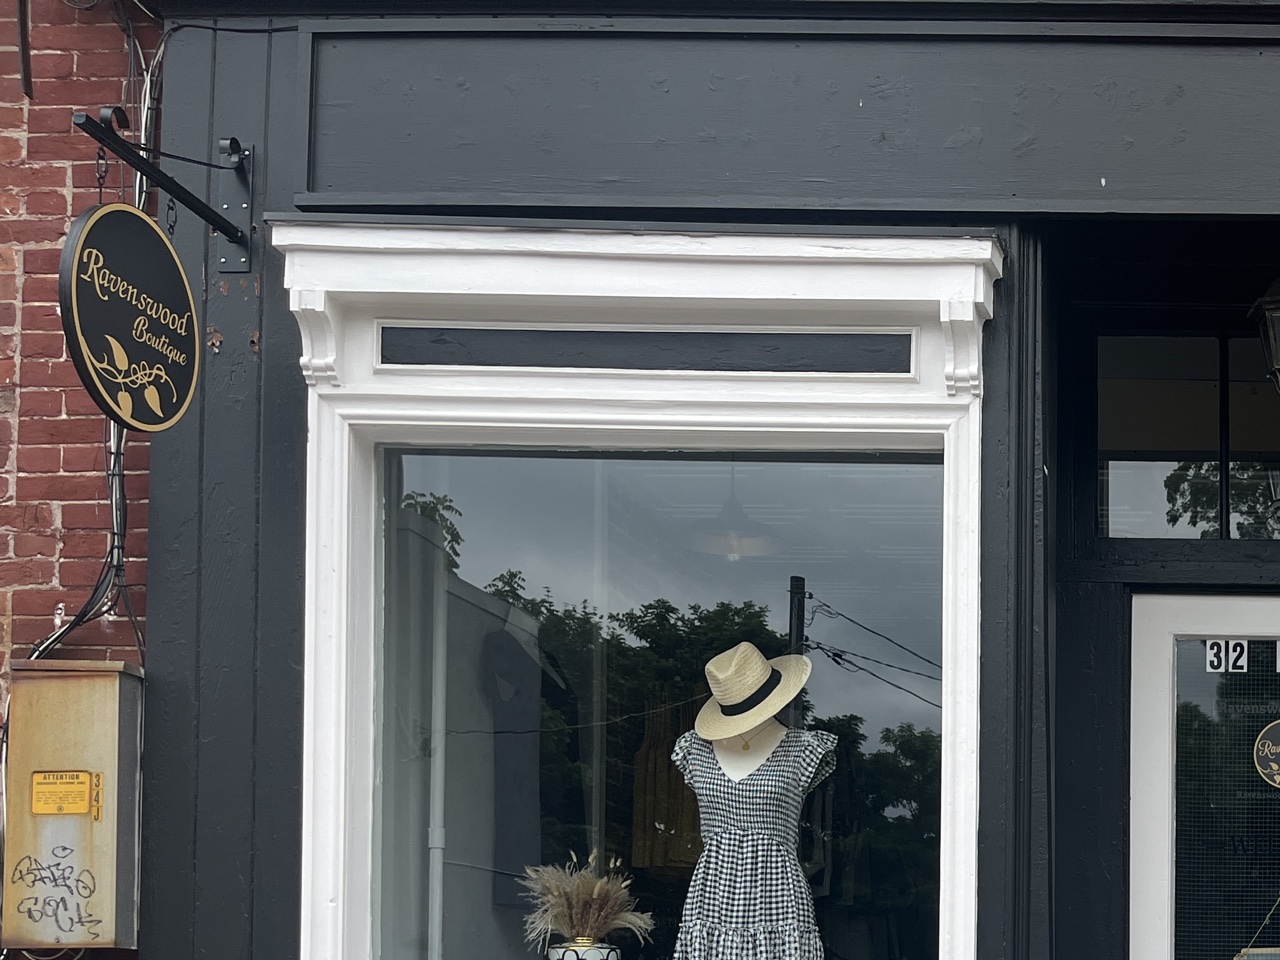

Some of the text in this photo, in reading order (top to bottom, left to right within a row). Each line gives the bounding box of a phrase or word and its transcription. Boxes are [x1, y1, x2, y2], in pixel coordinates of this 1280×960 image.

[80, 248, 191, 336] Ravenswood
[132, 316, 188, 366] Boutique
[1208, 641, 1245, 671] 32
